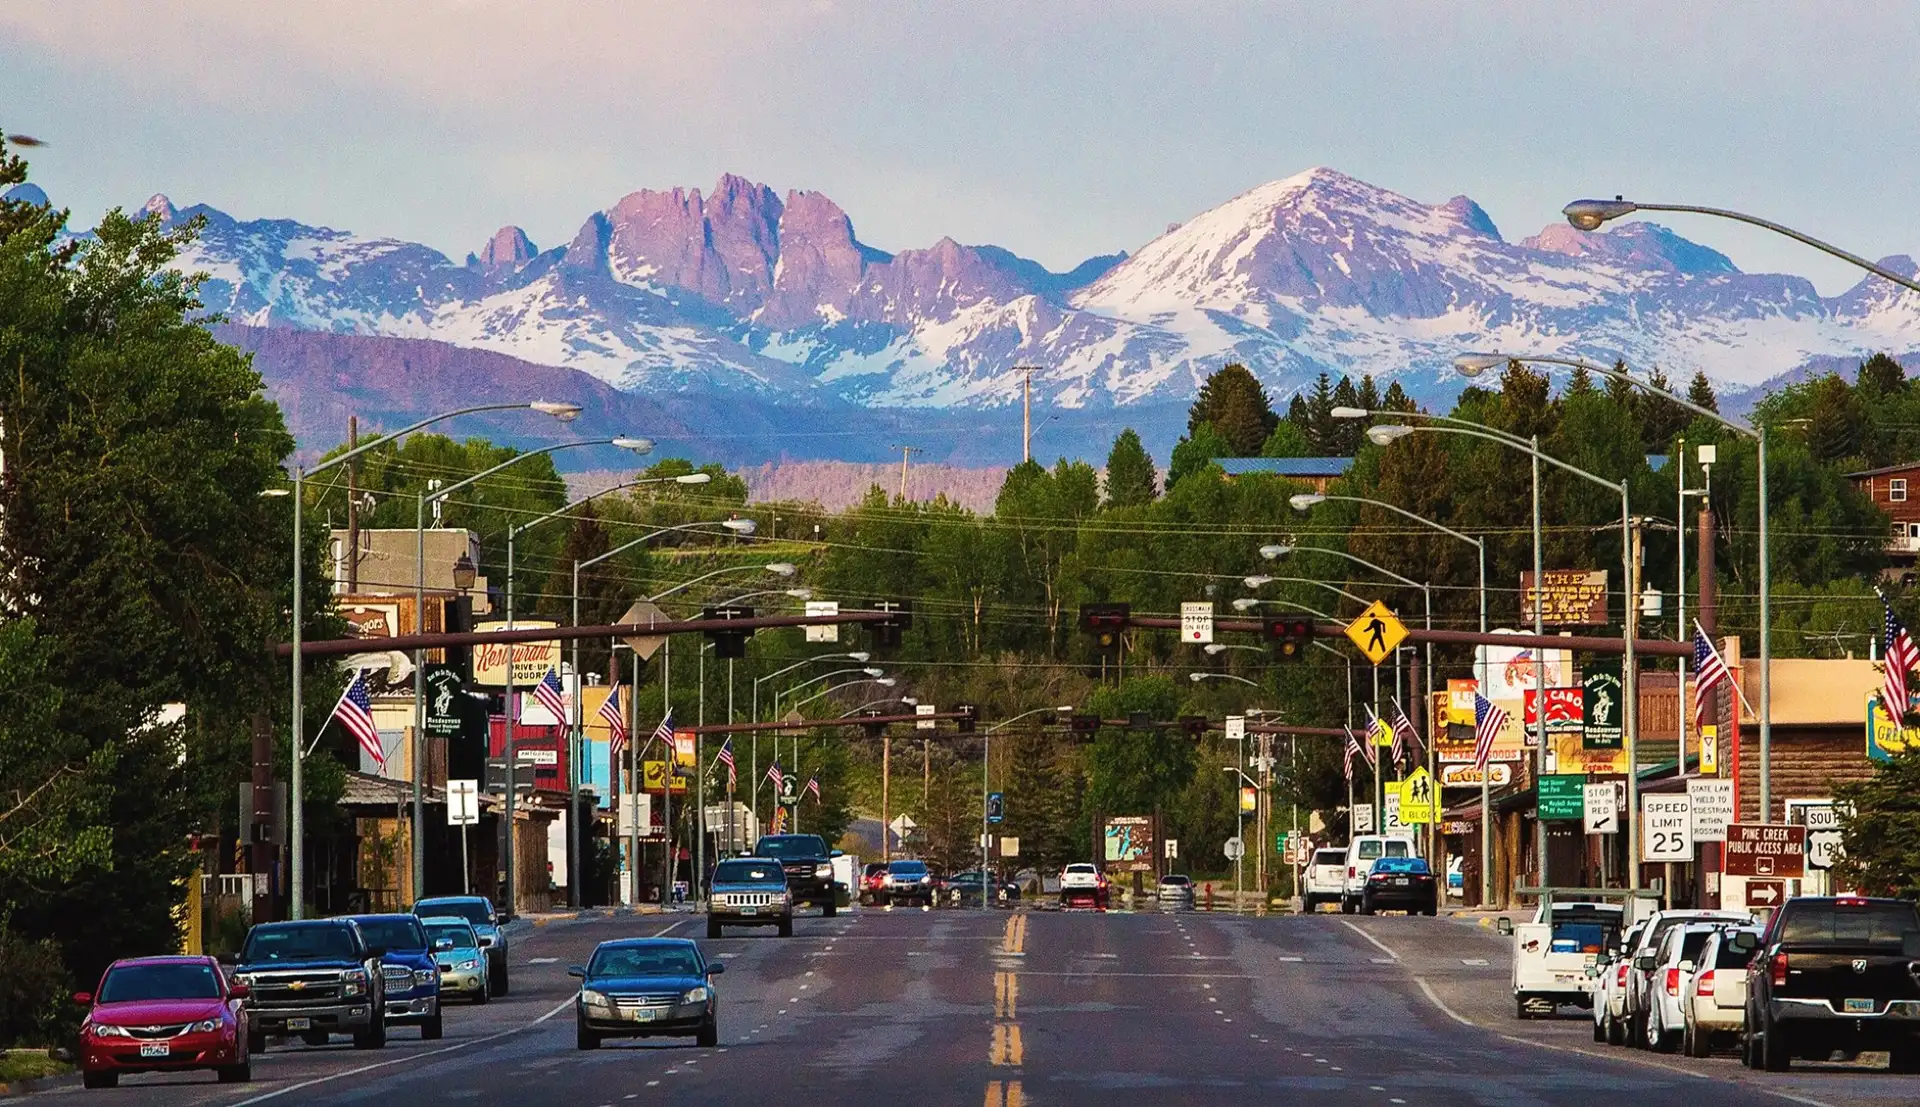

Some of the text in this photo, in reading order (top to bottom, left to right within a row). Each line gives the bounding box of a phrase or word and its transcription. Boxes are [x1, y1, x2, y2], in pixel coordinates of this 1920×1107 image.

[1544, 572, 1583, 585] THE
[1185, 615, 1209, 623] STOP
[474, 641, 554, 672] Resturant
[511, 663, 549, 671] RIVE-UP
[1442, 750, 1476, 760] PACKAG
[1447, 768, 1503, 783] MUSC
[1588, 788, 1611, 797] STOP
[1691, 785, 1730, 793] STATE LAW
[1695, 795, 1727, 804] YIELD TO
[1591, 807, 1610, 815] RED
[1647, 803, 1688, 813] SPEED
[1692, 806, 1732, 814] EDESTRIAN
[1651, 818, 1683, 828] LIMIT
[1810, 813, 1839, 825] SOUT
[1693, 827, 1726, 835] ROSSWAL
[1742, 827, 1789, 841] PINE CREEK
[1653, 832, 1684, 853] 25
[1728, 841, 1803, 855] PUBLIC ACCESS AREA
